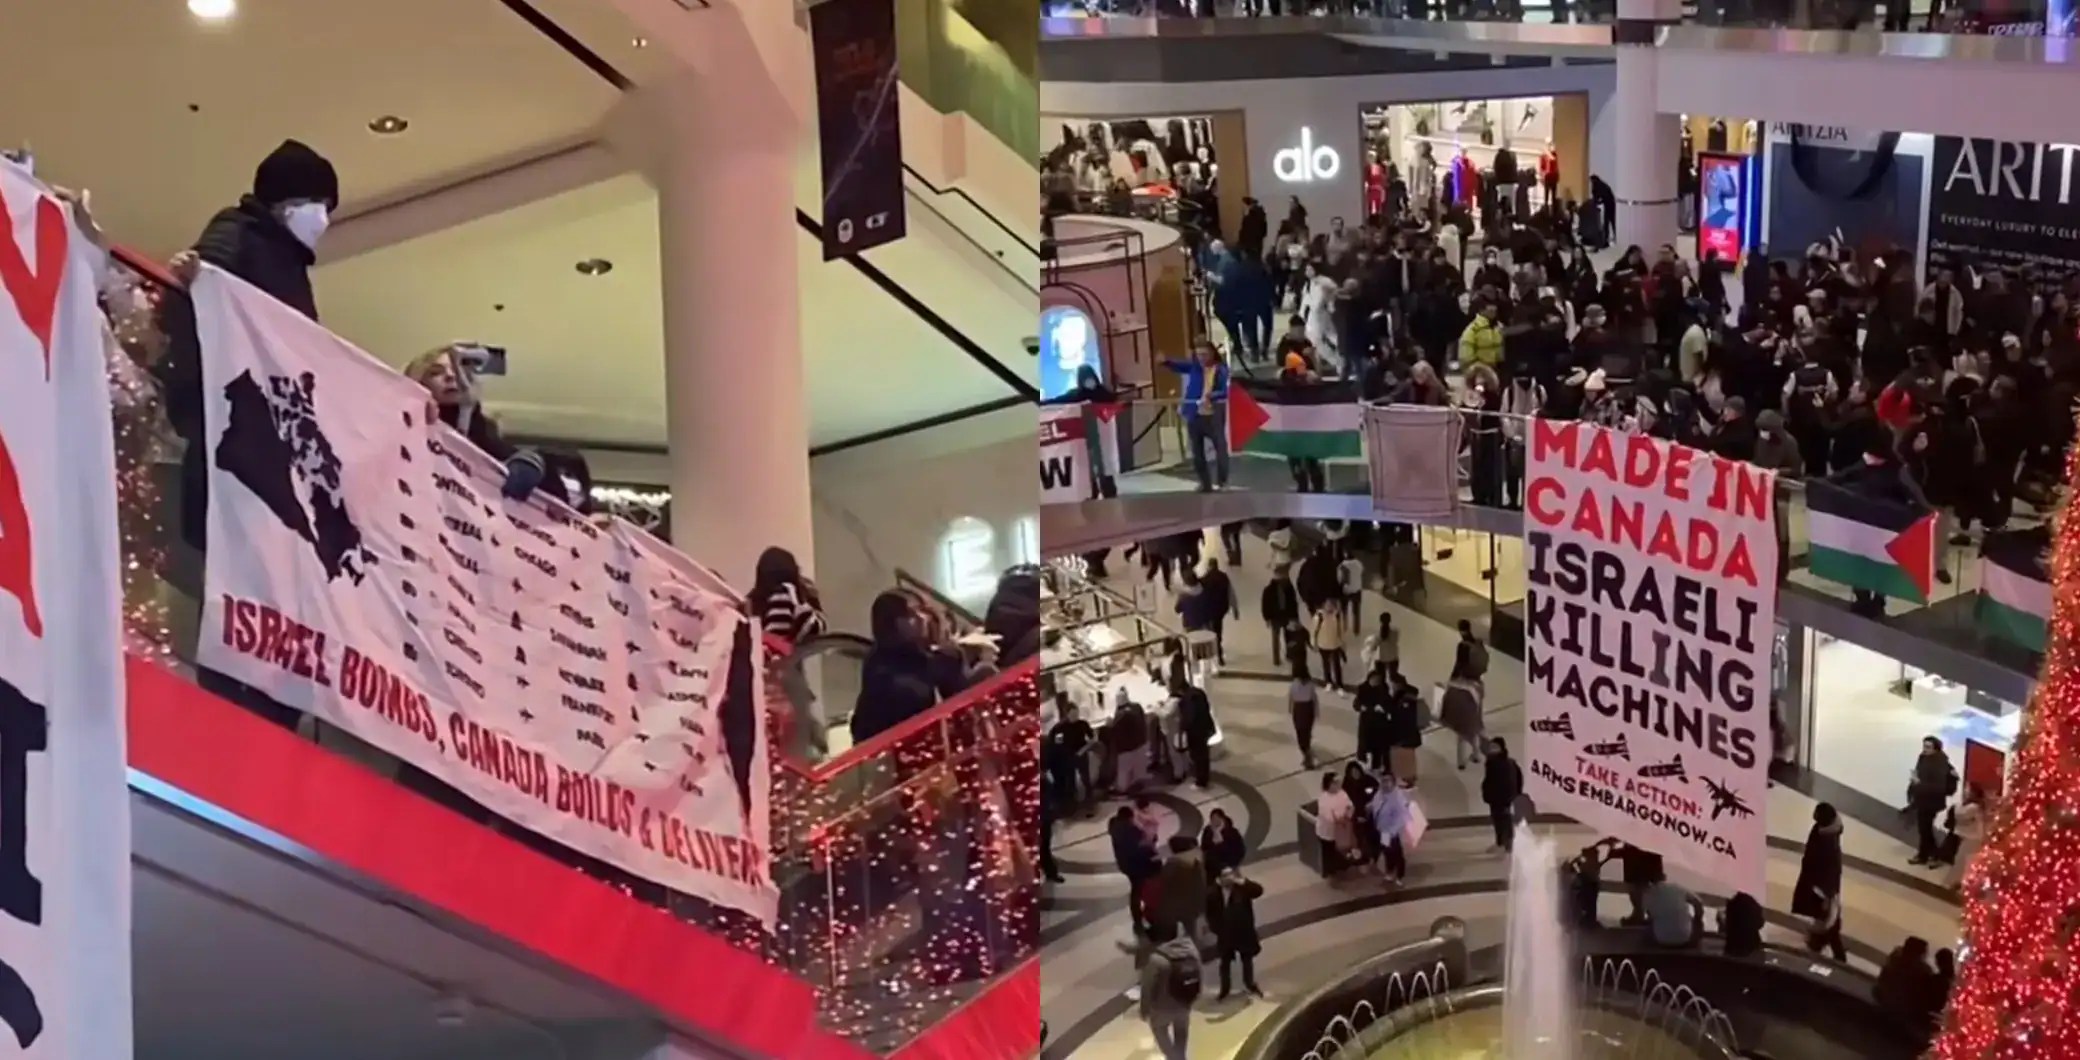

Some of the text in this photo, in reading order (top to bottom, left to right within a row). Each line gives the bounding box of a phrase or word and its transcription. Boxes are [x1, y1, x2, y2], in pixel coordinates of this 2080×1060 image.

[1273, 126, 1340, 181] alo
[1944, 137, 2080, 204] ARIT
[1941, 213, 1993, 228] EVERYDAY
[2041, 225, 2056, 236] TO
[1533, 419, 1767, 521] MADE IN
[1527, 476, 1758, 587] CANADA
[1528, 531, 1758, 653] ISRAELI
[1527, 589, 1754, 712] KILLING
[222, 593, 331, 687] ISRAEL
[340, 645, 446, 753] BOMBS,
[449, 712, 549, 804] CANADA
[639, 806, 655, 851] &
[1528, 645, 1756, 769] MACHINES
[1575, 756, 1703, 819] TAKE ACTION:
